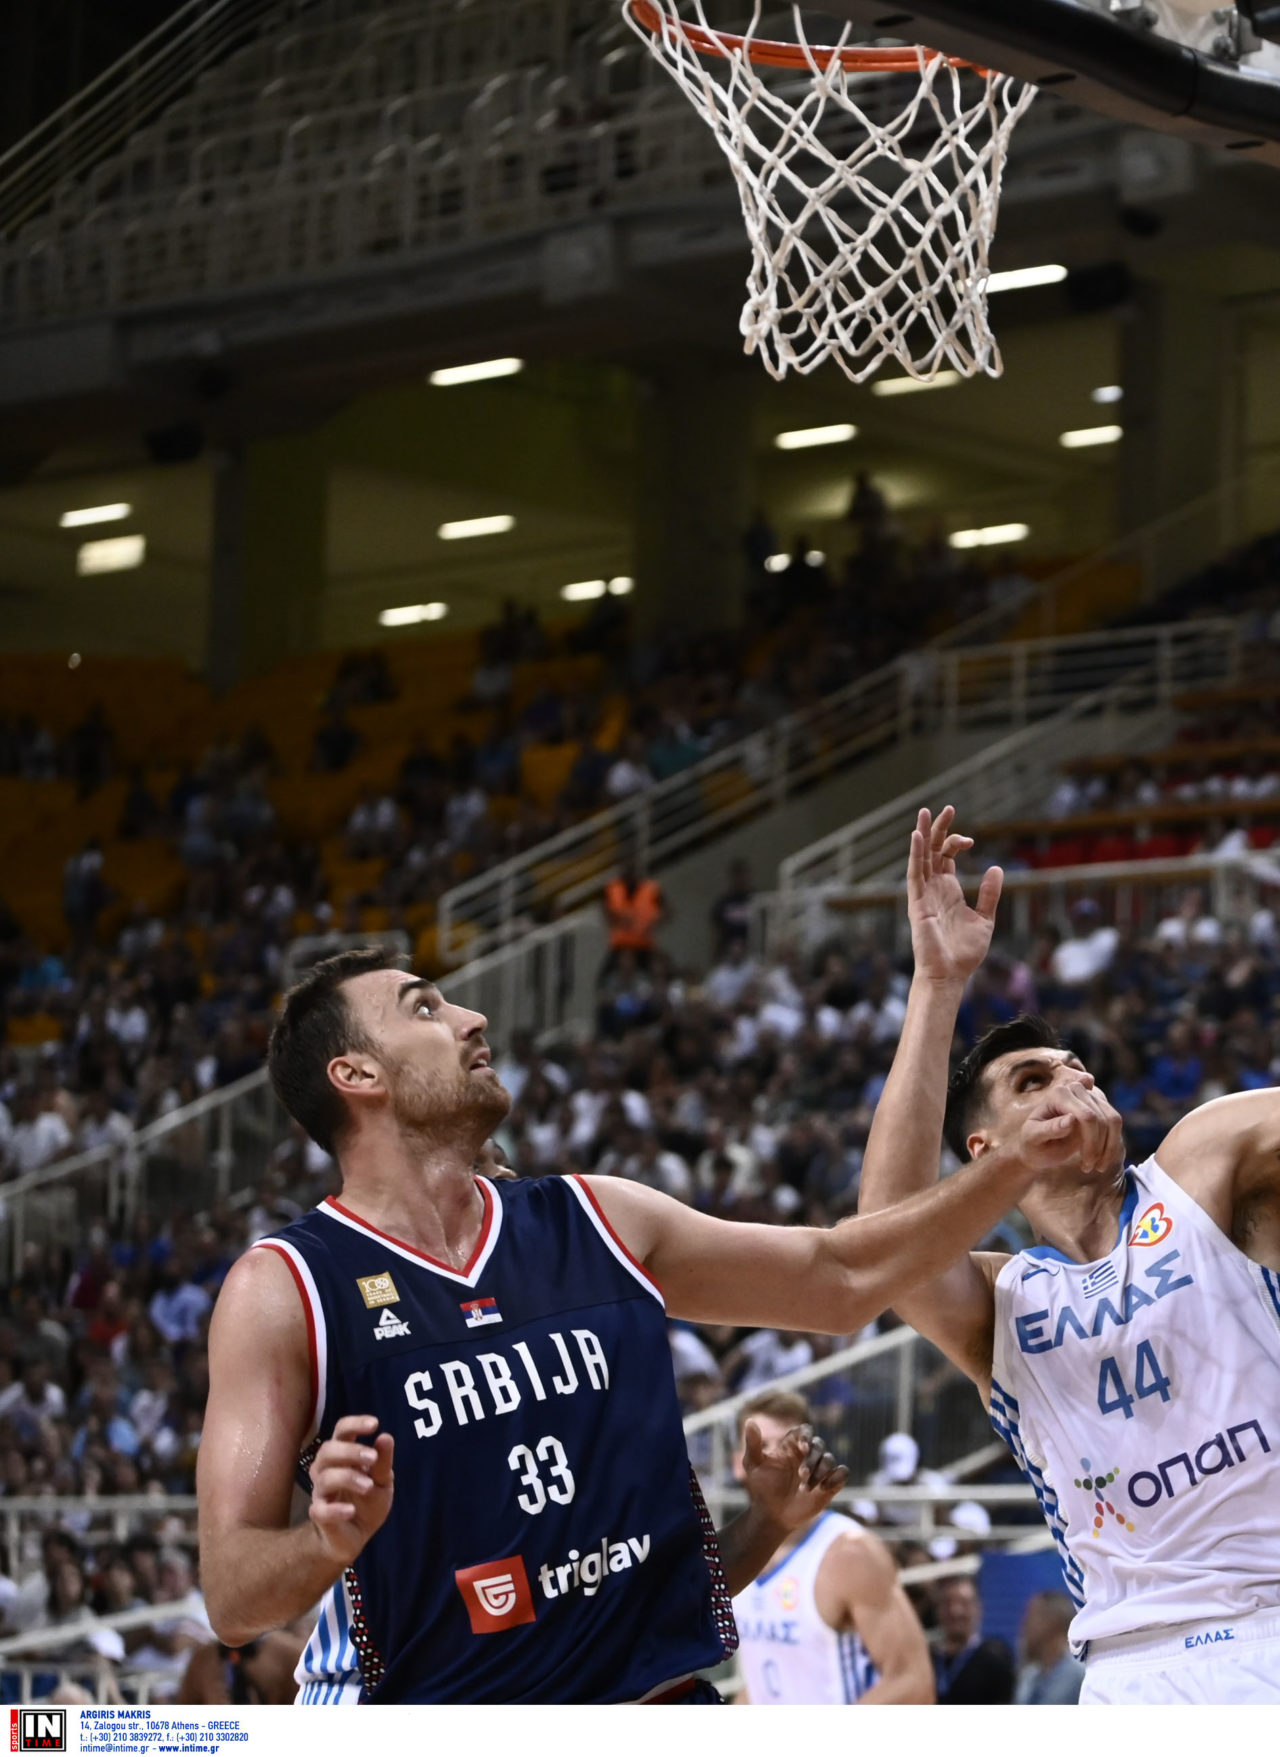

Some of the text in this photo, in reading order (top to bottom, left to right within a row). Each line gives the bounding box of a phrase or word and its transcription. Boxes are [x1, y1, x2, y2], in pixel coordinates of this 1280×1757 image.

[373, 1321, 412, 1341] PEAK
[1015, 1249, 1194, 1354] ΕΛΛΑΣ
[404, 1329, 610, 1439] SRBIJA
[1097, 1339, 1171, 1419] 44
[507, 1435, 576, 1516] 33
[538, 1534, 651, 1599] triglav
[1184, 1627, 1235, 1649] ΕΛΛΑΣ
